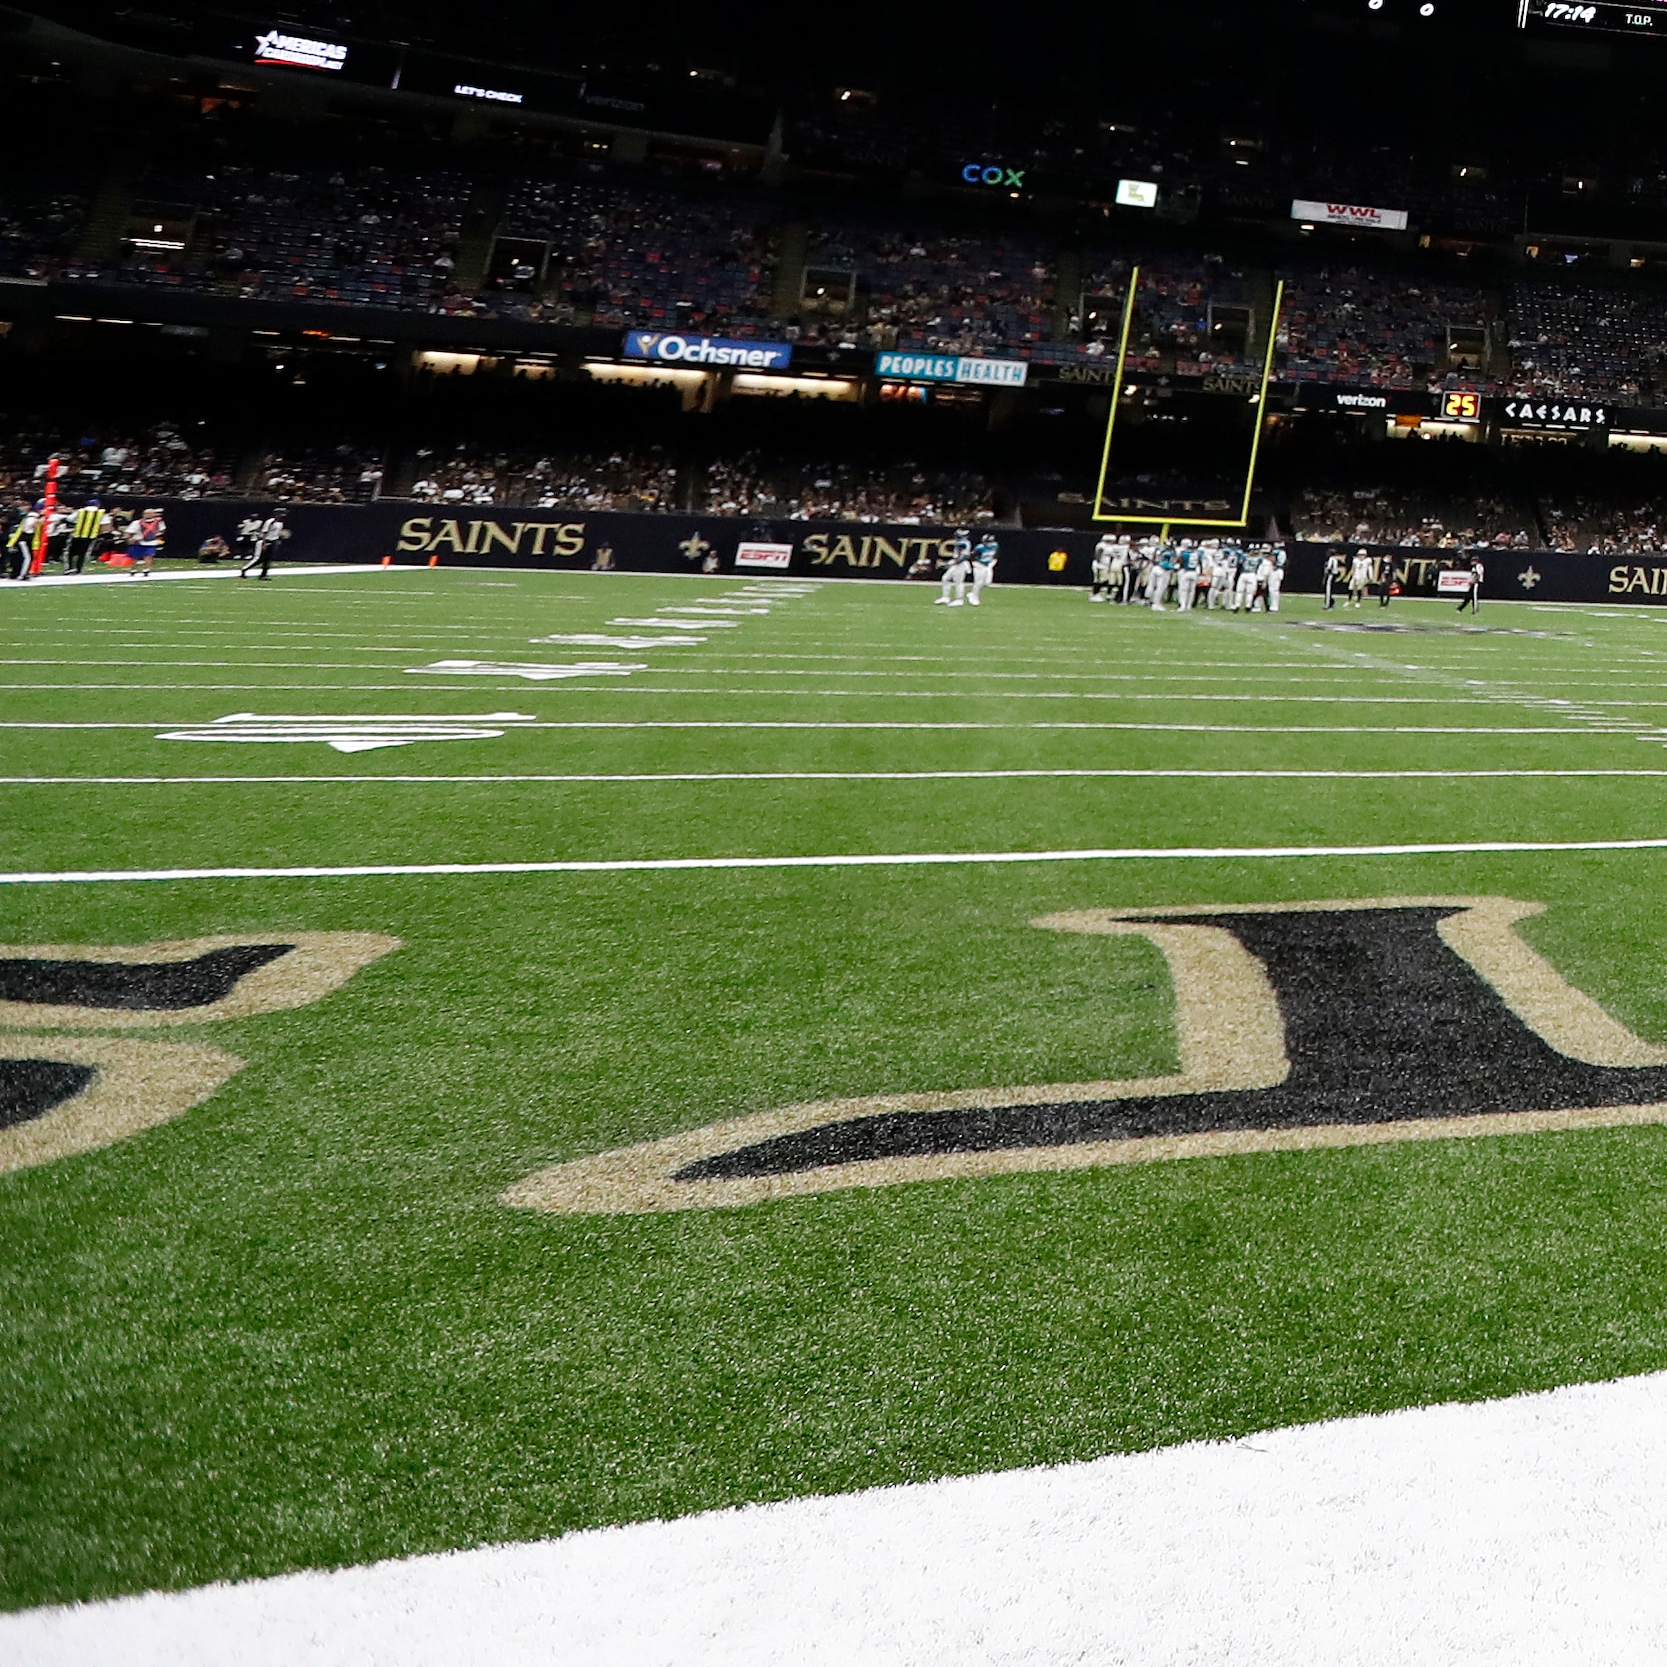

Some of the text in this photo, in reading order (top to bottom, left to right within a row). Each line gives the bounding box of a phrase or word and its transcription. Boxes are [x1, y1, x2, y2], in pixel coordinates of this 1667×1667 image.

[1419, 3, 1434, 17] 0
[1544, 3, 1597, 24] 17:14
[264, 30, 347, 60] AMERICAS
[961, 164, 1025, 188] COX
[1327, 204, 1381, 218] WWL
[657, 335, 779, 368] Ochsner
[879, 355, 1022, 383] PEOPLES HEALTH
[1337, 394, 1386, 408] verizon
[1446, 394, 1475, 417] 25
[1505, 402, 1606, 424] CAESARS
[396, 515, 586, 558] SAINTS
[739, 548, 788, 562] ESPN
